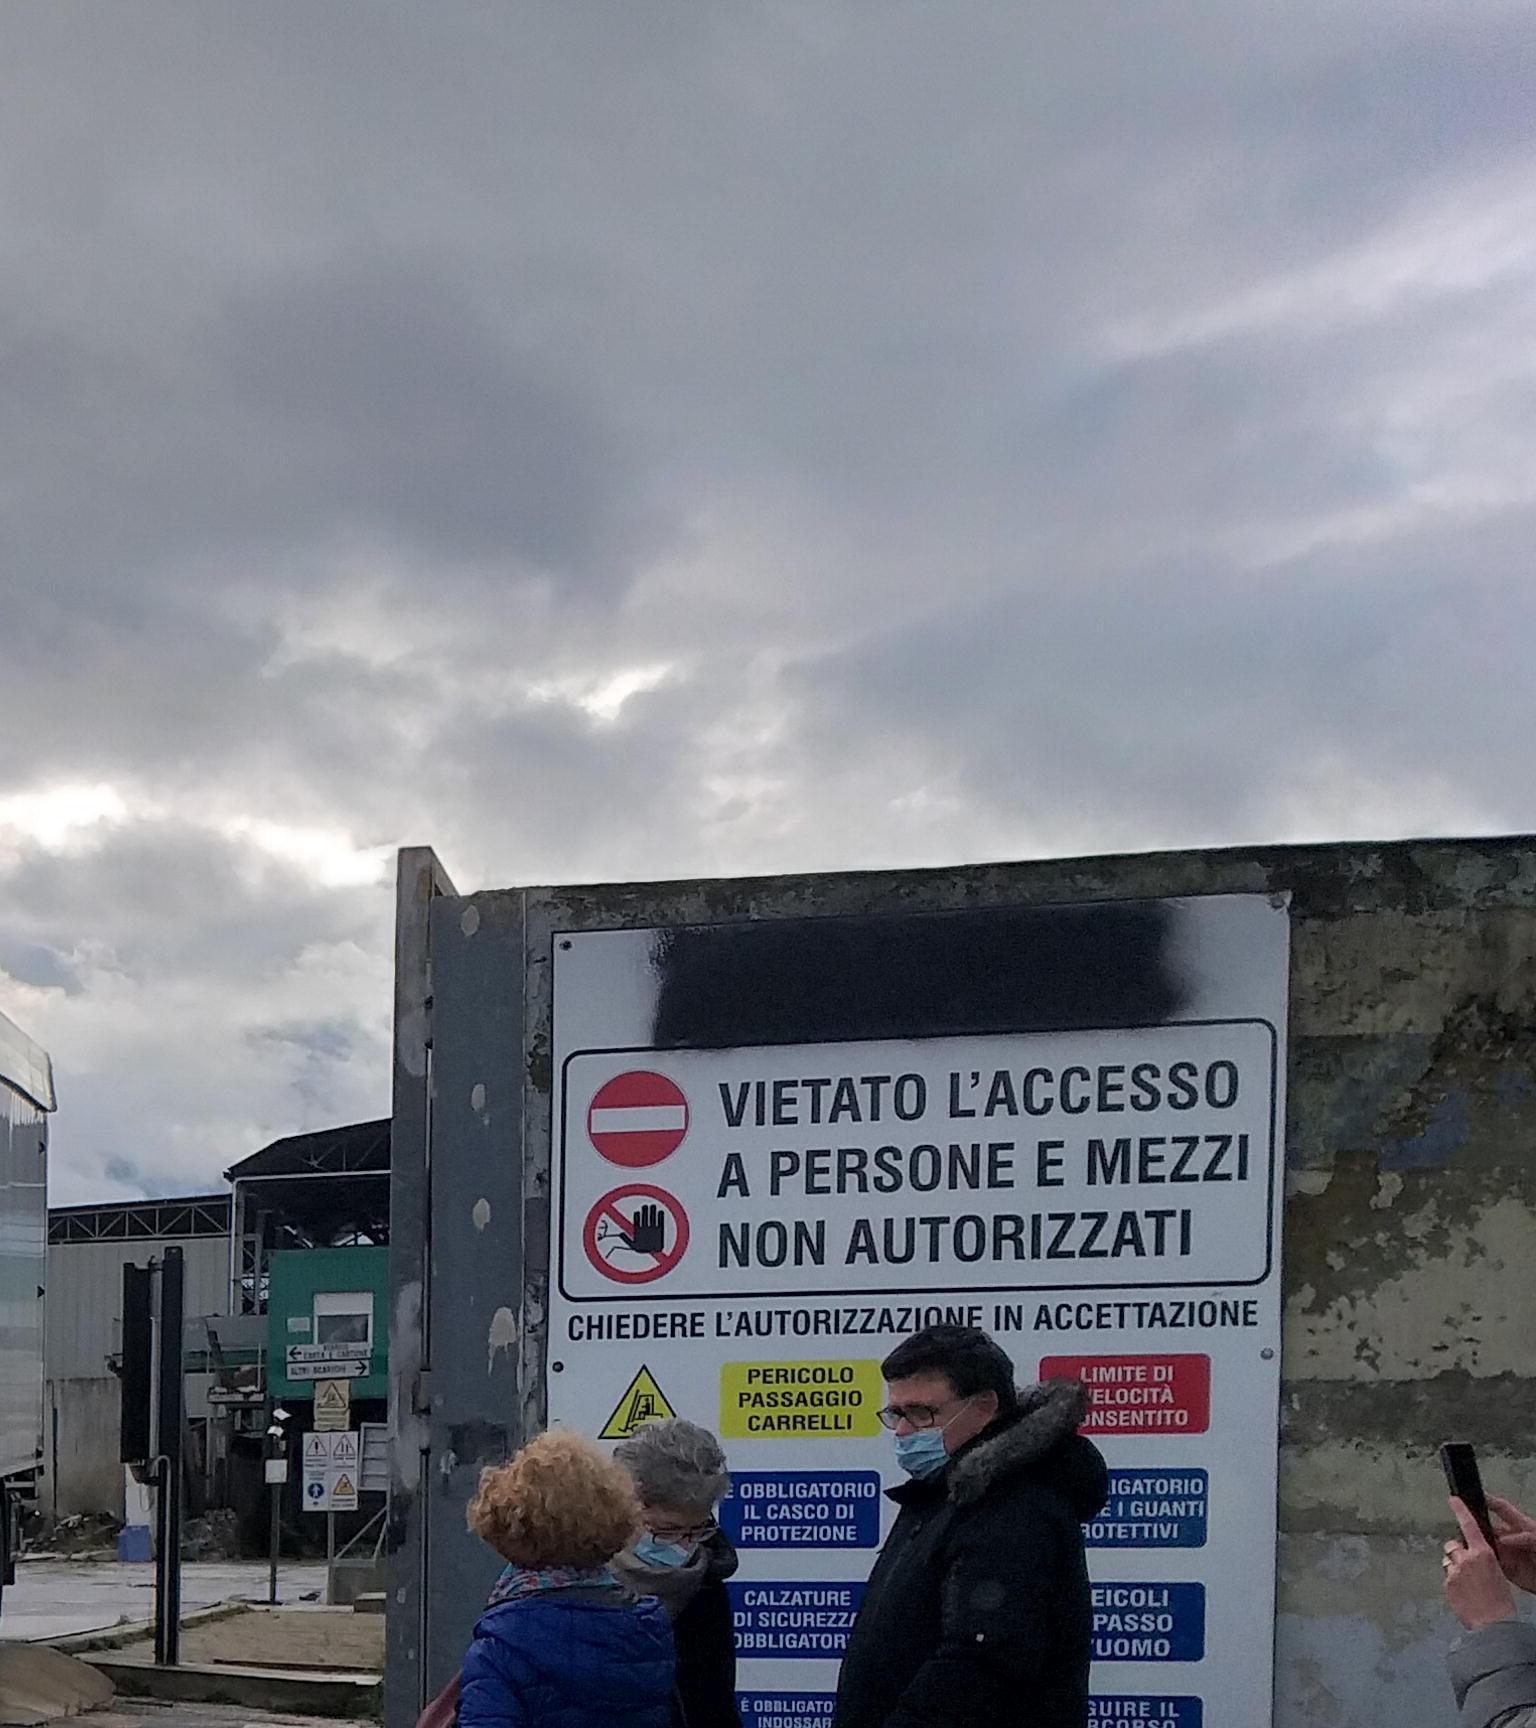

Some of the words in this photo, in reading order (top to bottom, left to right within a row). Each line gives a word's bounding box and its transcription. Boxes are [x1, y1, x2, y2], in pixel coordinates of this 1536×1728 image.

[718, 1073, 927, 1128] VIETATO
[949, 1060, 1239, 1119] L'ACCESSO
[716, 1153, 750, 1198] A
[770, 1142, 1015, 1196] PERSONE
[1037, 1140, 1065, 1187] E
[1086, 1134, 1249, 1186] MEZZI
[718, 1220, 826, 1268] NON
[845, 1209, 1192, 1265] AUTORIZZATI
[568, 1312, 705, 1341] CHIEDERE
[716, 1306, 983, 1337] L'AUTORIZZAZIONE
[994, 1305, 1023, 1331] IN
[1033, 1300, 1258, 1331] ACCETTAZIONE
[747, 1367, 854, 1384] PERICOLO
[1080, 1366, 1147, 1383] LIMITE
[1154, 1365, 1173, 1382] DI
[738, 1390, 863, 1408] PASSAGGIO
[1087, 1384, 1174, 1405] ELOCITÀ
[748, 1414, 852, 1431] CARRELLI
[740, 1482, 876, 1499] OBBLIGATORIO
[1108, 1479, 1204, 1495] IGATORIO
[744, 1505, 761, 1519] IL
[767, 1504, 829, 1520] CASCO
[836, 1504, 854, 1519] DI
[1130, 1501, 1204, 1518] GUANTI
[741, 1526, 857, 1541] PROTEZIONE
[1080, 1523, 1178, 1539] ROTETTIVI
[744, 1590, 851, 1606] CALZATURE
[1091, 1589, 1169, 1607] EICOLI
[733, 1612, 752, 1627] DI
[1093, 1614, 1174, 1632] PASSO
[734, 1633, 851, 1649] OBBLIGATOR
[1090, 1638, 1171, 1657] 'UOMO
[754, 1700, 835, 1713] OBBLIGATO
[1087, 1702, 1151, 1717] GUIRE
[1160, 1702, 1179, 1717] IL
[758, 1717, 834, 1728] INDOSSAR
